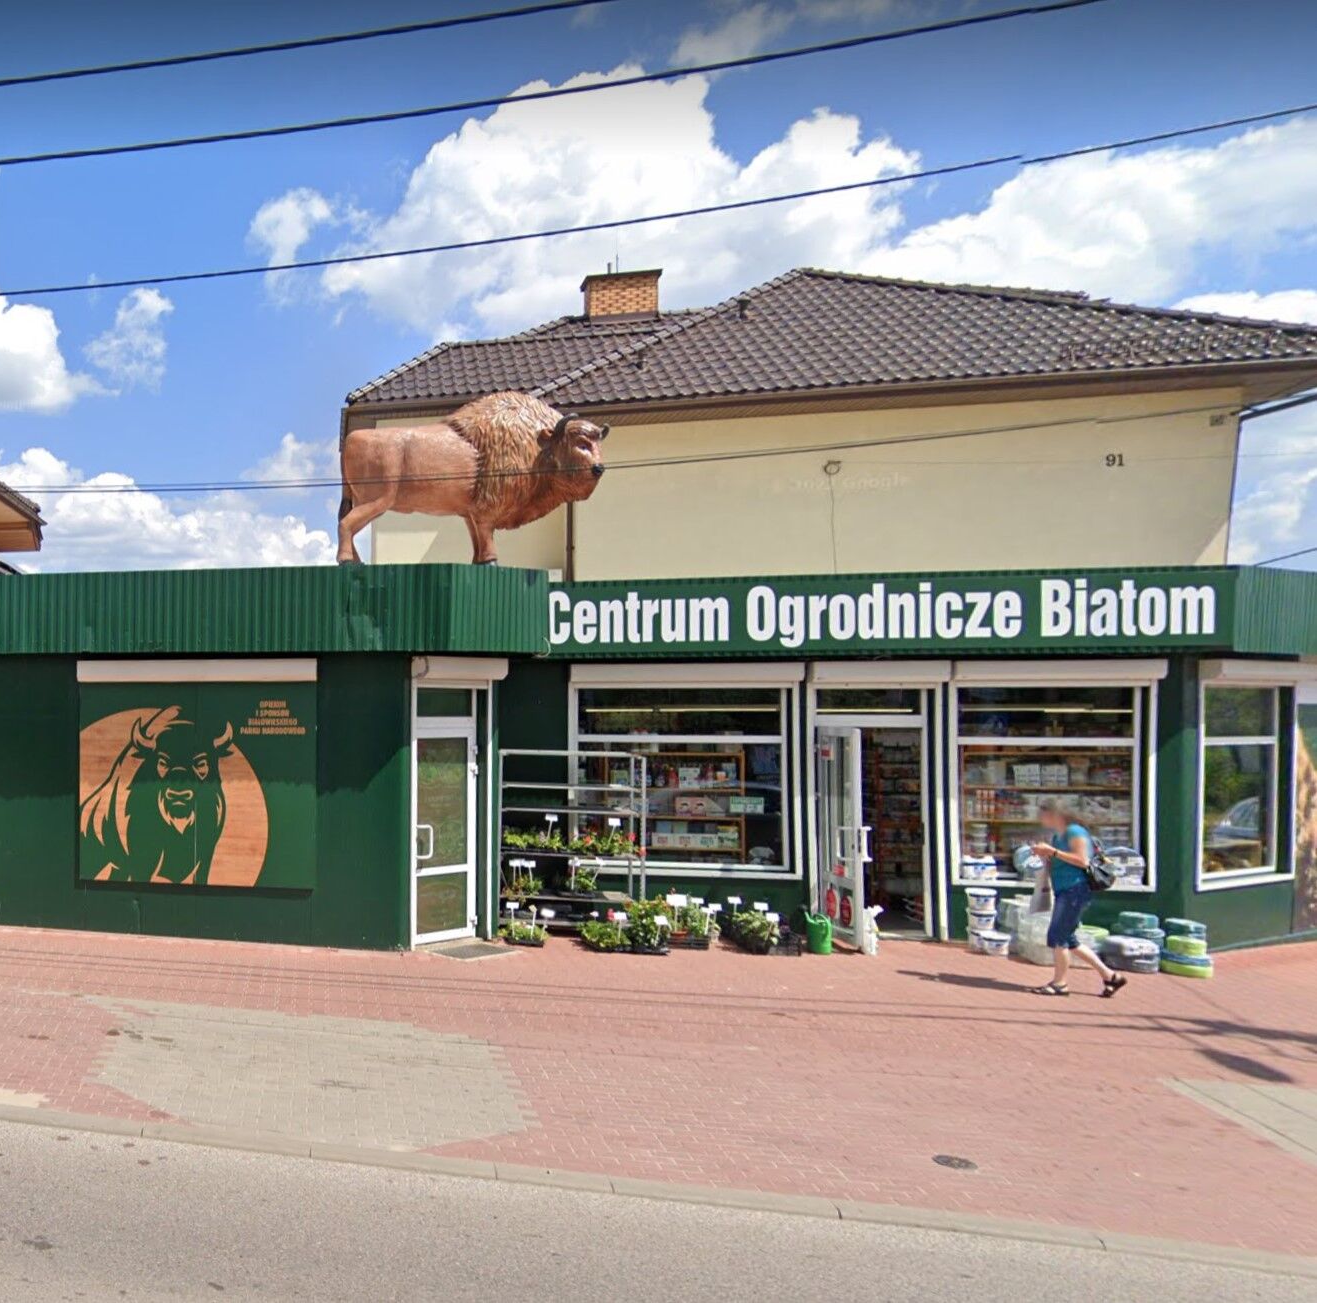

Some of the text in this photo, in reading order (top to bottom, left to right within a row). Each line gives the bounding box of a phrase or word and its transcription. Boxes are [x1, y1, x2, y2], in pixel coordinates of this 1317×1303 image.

[1105, 453, 1124, 467] 91
[549, 579, 1215, 647] Centrum Ogrodnicze Biatom
